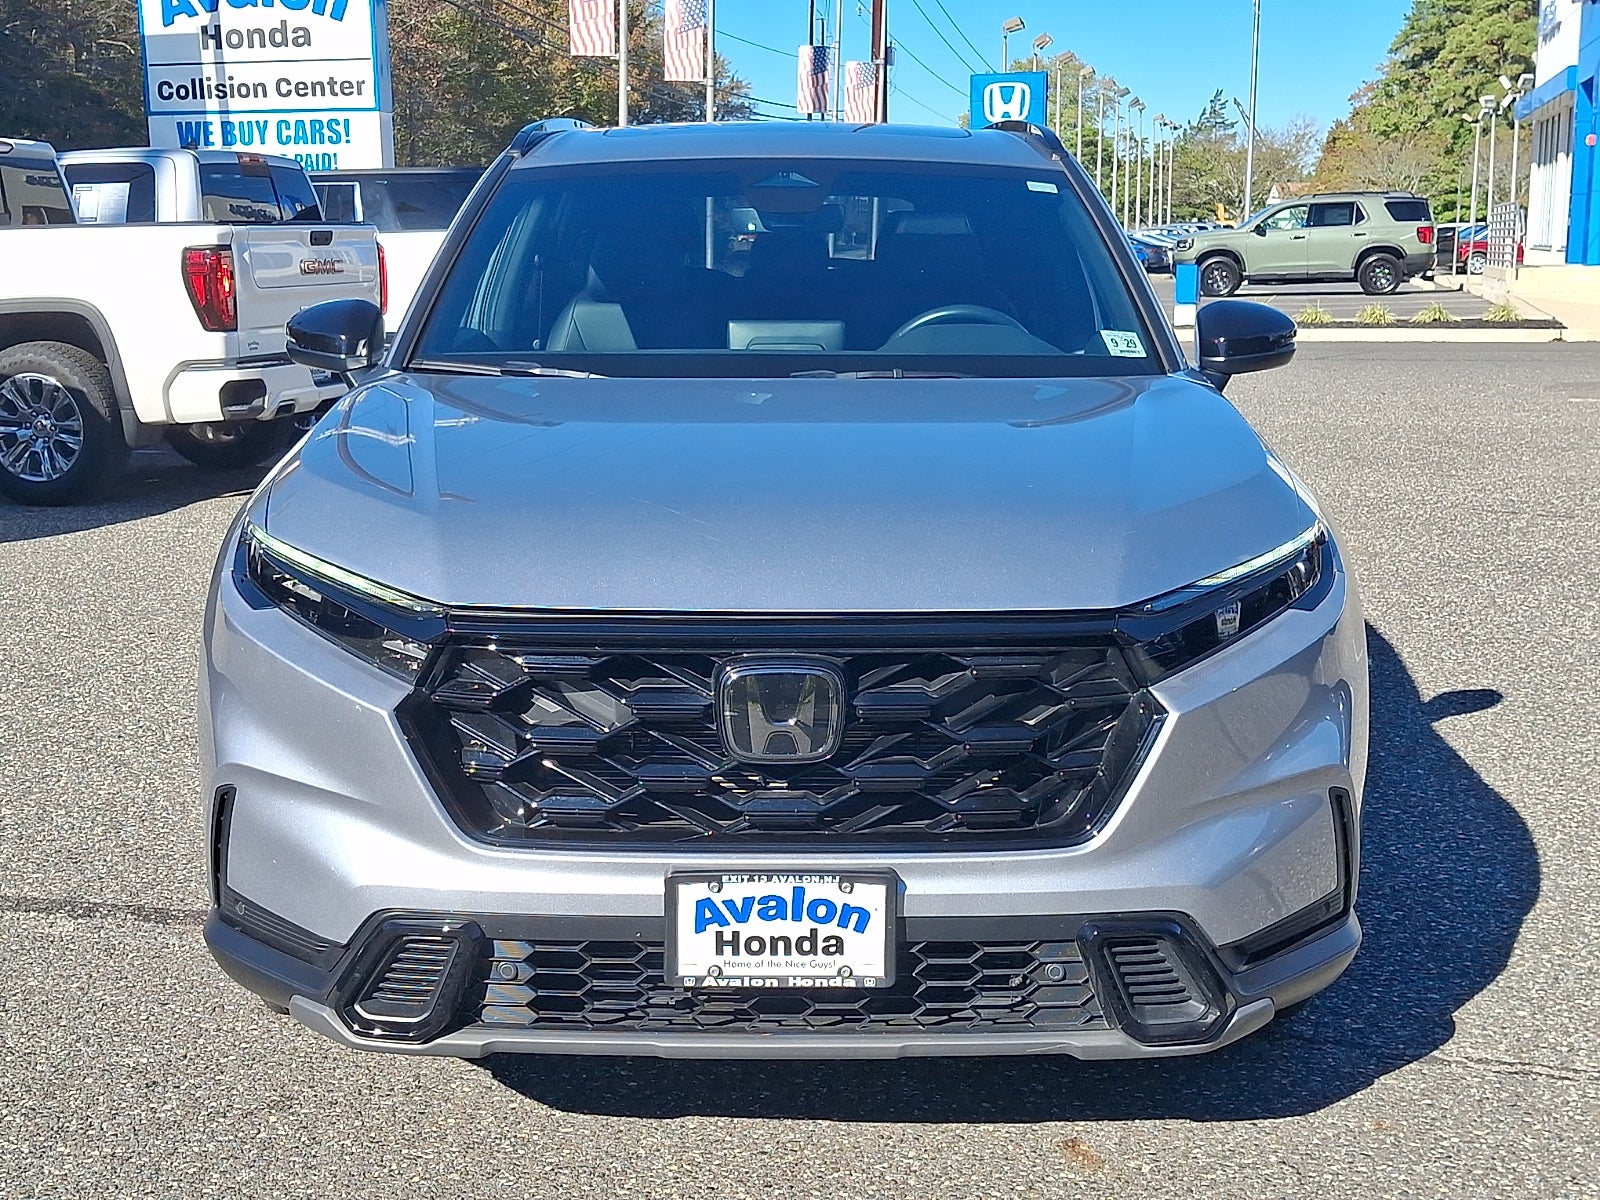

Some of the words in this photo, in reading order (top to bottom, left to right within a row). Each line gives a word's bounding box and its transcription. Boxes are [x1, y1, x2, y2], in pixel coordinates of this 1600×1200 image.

[200, 20, 312, 50] Honda
[157, 76, 267, 100] Collision
[275, 77, 366, 98] Center
[176, 121, 215, 147] WE
[220, 120, 268, 147] BUY
[276, 118, 351, 145] CARS!
[294, 152, 338, 171] PAID!
[301, 258, 345, 275] GMC
[1123, 338, 1137, 349] 29
[721, 875, 750, 884] EXIT
[695, 886, 871, 934] Avalon
[715, 928, 845, 956] Honda
[723, 959, 752, 969] Home
[754, 959, 765, 969] of
[767, 959, 782, 969] the
[785, 959, 807, 969] Nice
[809, 959, 837, 970] Guys!
[701, 976, 780, 987] Avalon
[787, 976, 857, 987] Honda
